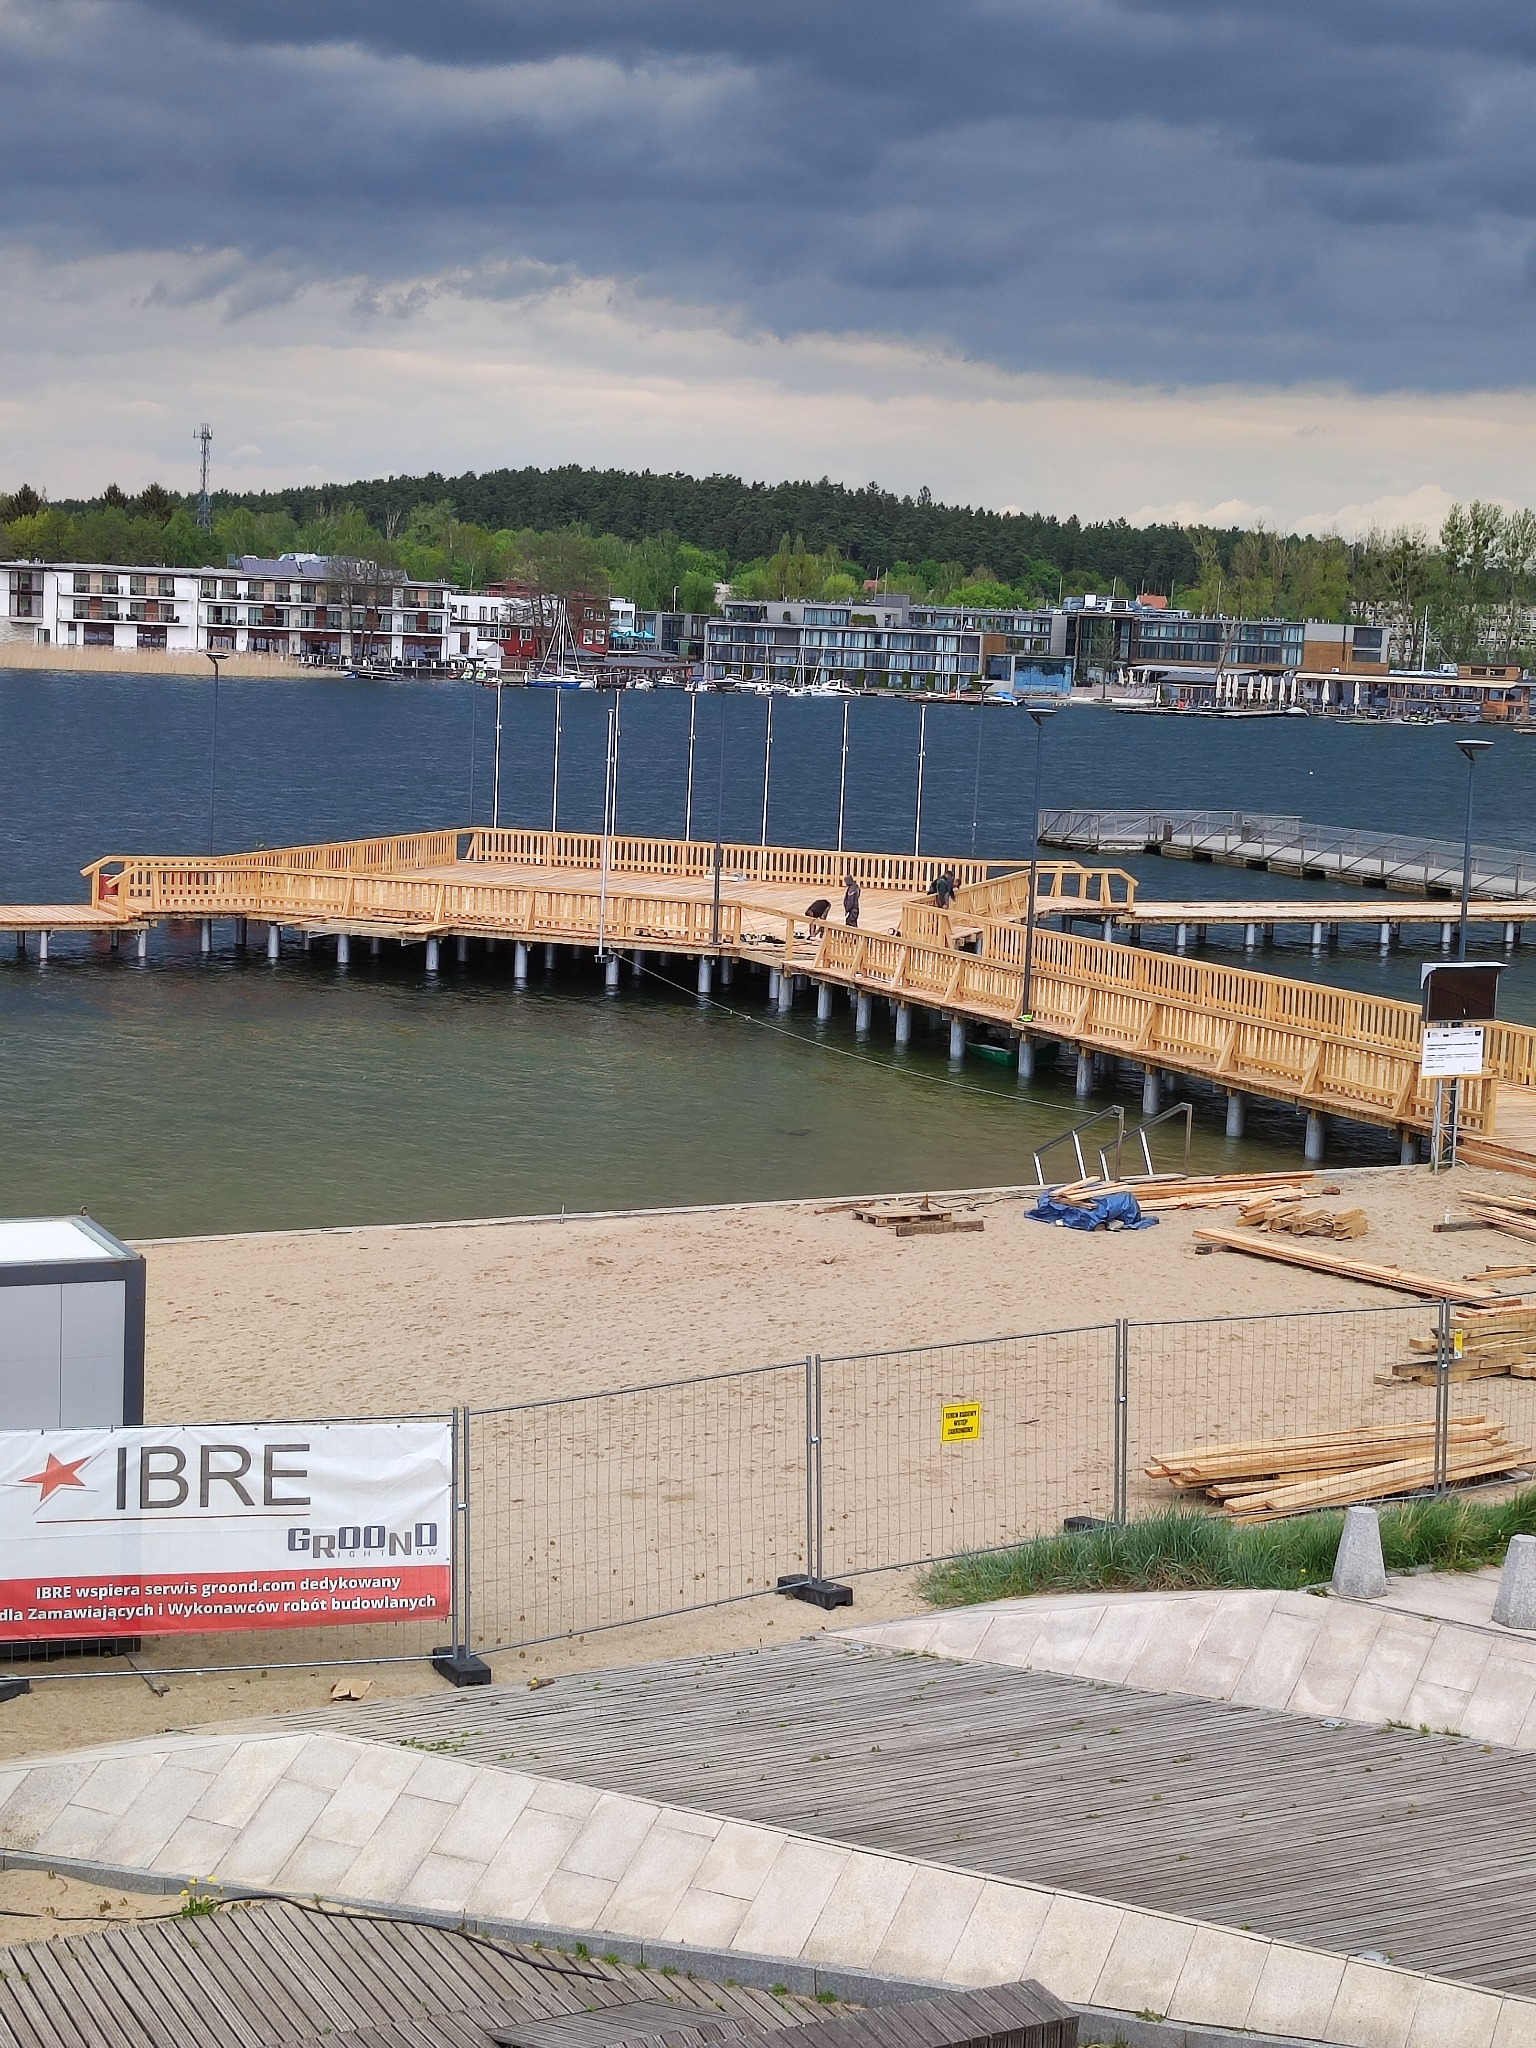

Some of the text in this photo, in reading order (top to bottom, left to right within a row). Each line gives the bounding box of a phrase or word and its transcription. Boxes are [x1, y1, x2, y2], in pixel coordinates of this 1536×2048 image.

[116, 1443, 311, 1510] IBRE
[36, 1576, 401, 1600] IBRE wspiera serwis groond.com dedykowany
[0, 1594, 436, 1622] dla Zamawiających i Wykonawców robót budowlanych
